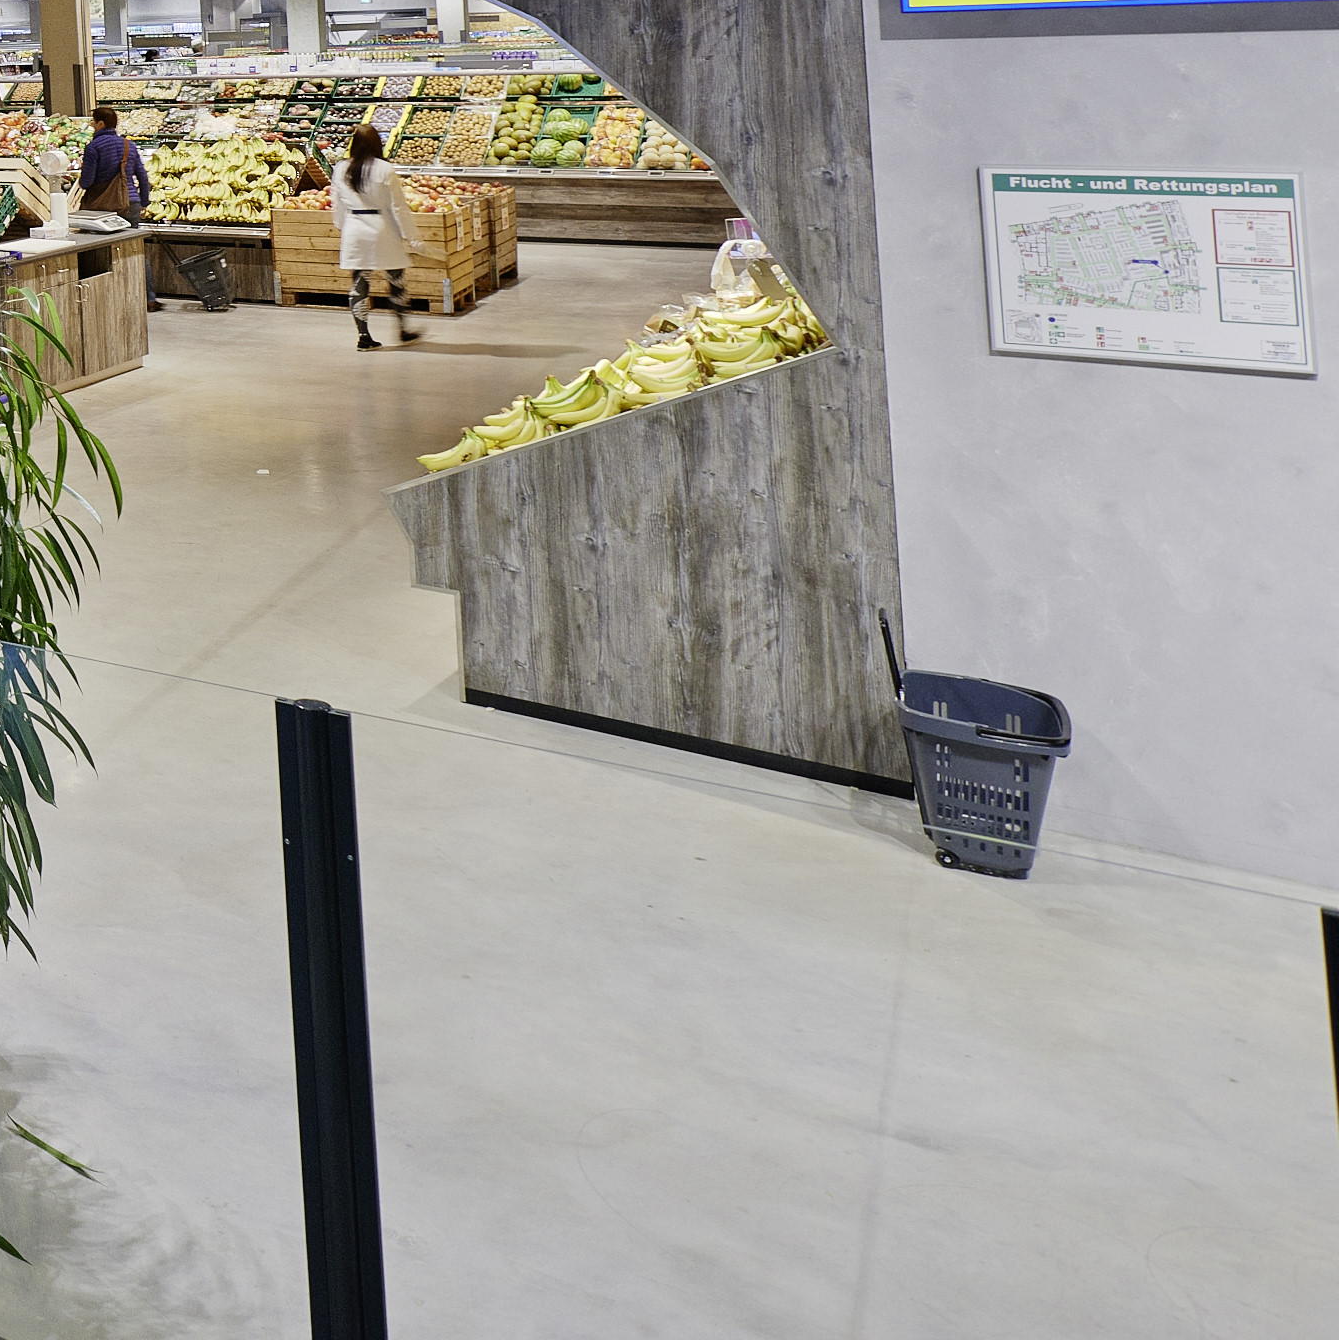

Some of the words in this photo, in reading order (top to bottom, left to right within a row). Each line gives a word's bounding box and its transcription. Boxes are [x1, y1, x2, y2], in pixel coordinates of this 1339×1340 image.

[1009, 176, 1071, 189] Flucht
[1090, 178, 1127, 190] und
[1134, 179, 1278, 195] Rettungsplan
